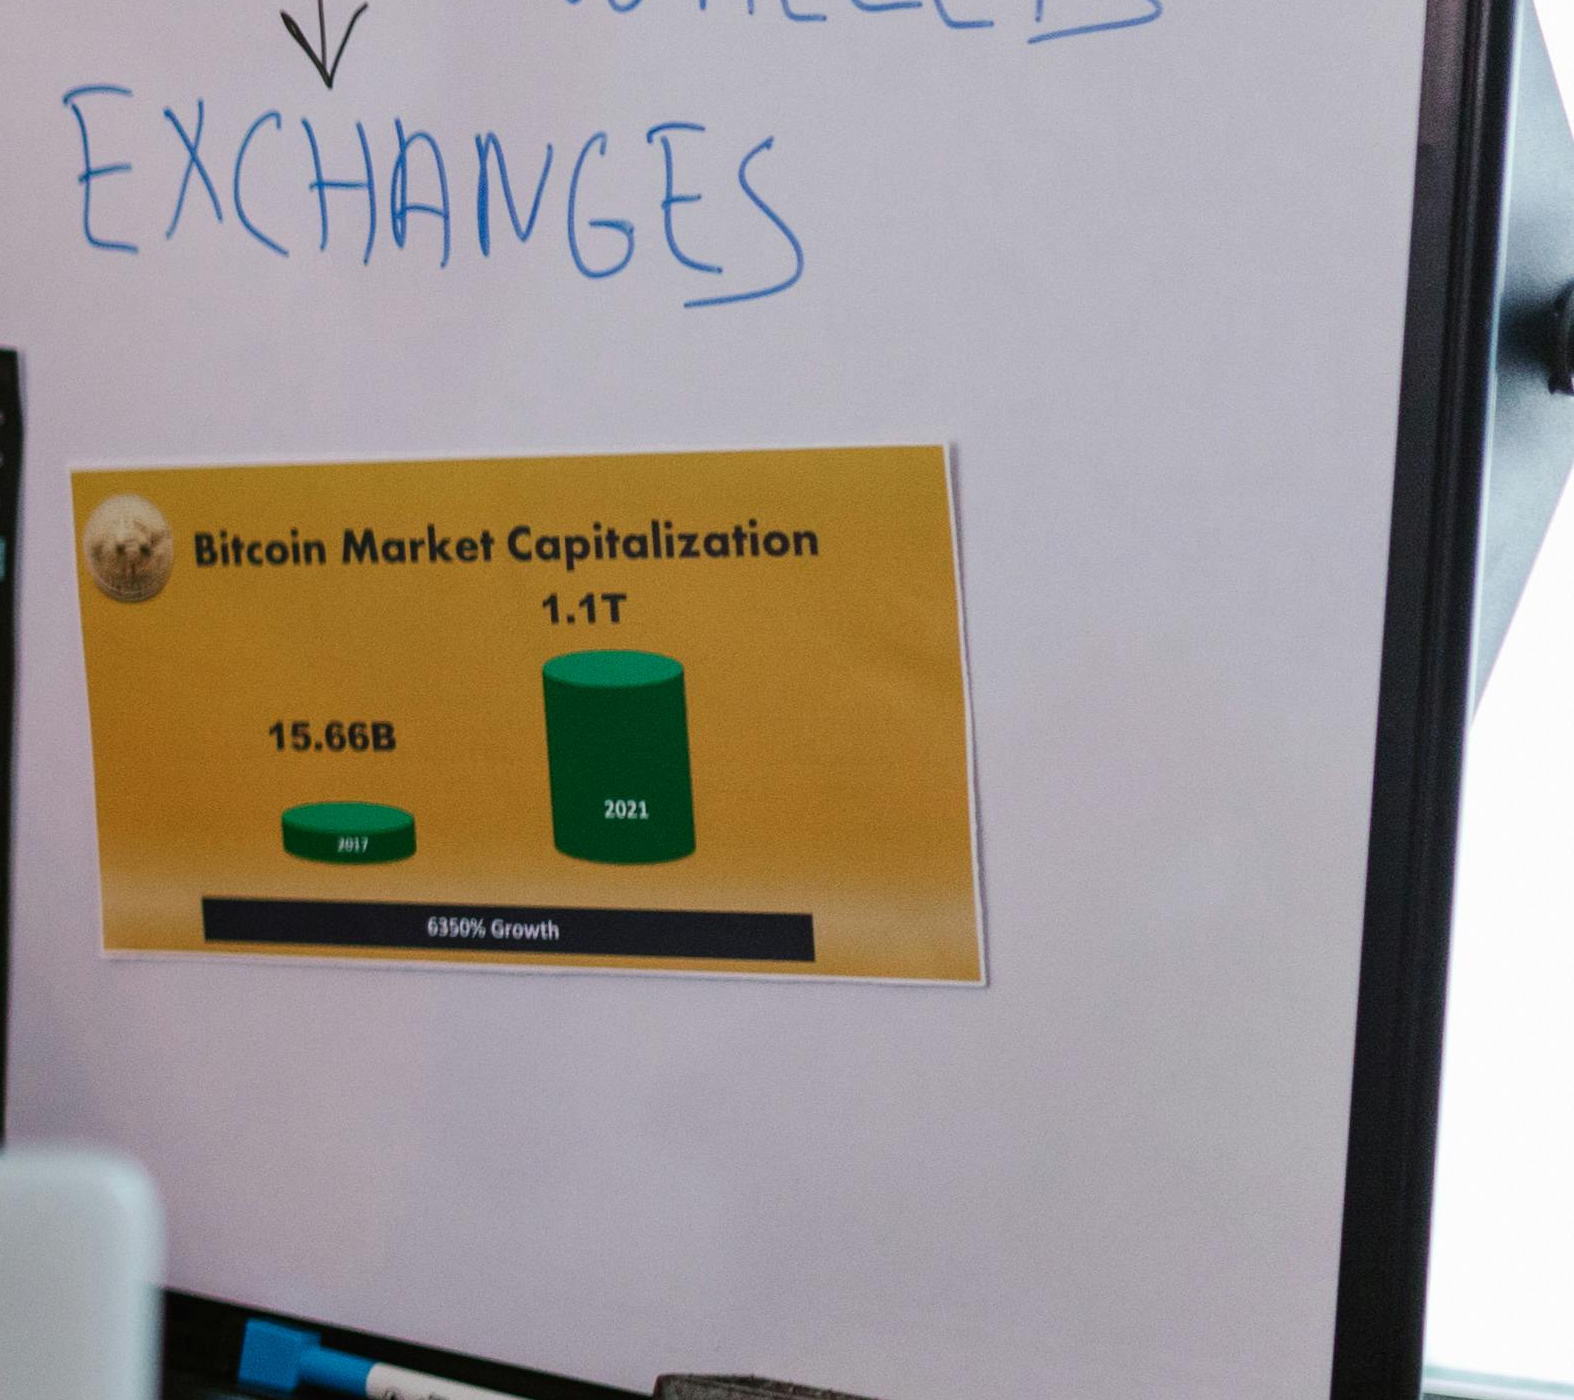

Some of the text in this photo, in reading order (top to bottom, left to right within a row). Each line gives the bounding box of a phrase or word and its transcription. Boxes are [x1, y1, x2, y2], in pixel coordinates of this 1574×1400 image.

[61, 83, 805, 309] EXCHANGES
[194, 518, 820, 572] Bitcoin Market Capitalization
[542, 592, 628, 625] 1.1T
[268, 720, 397, 753] 15.66B
[604, 800, 649, 820] 2021
[337, 836, 369, 854] 2017
[427, 916, 560, 940] 6350% Growth
